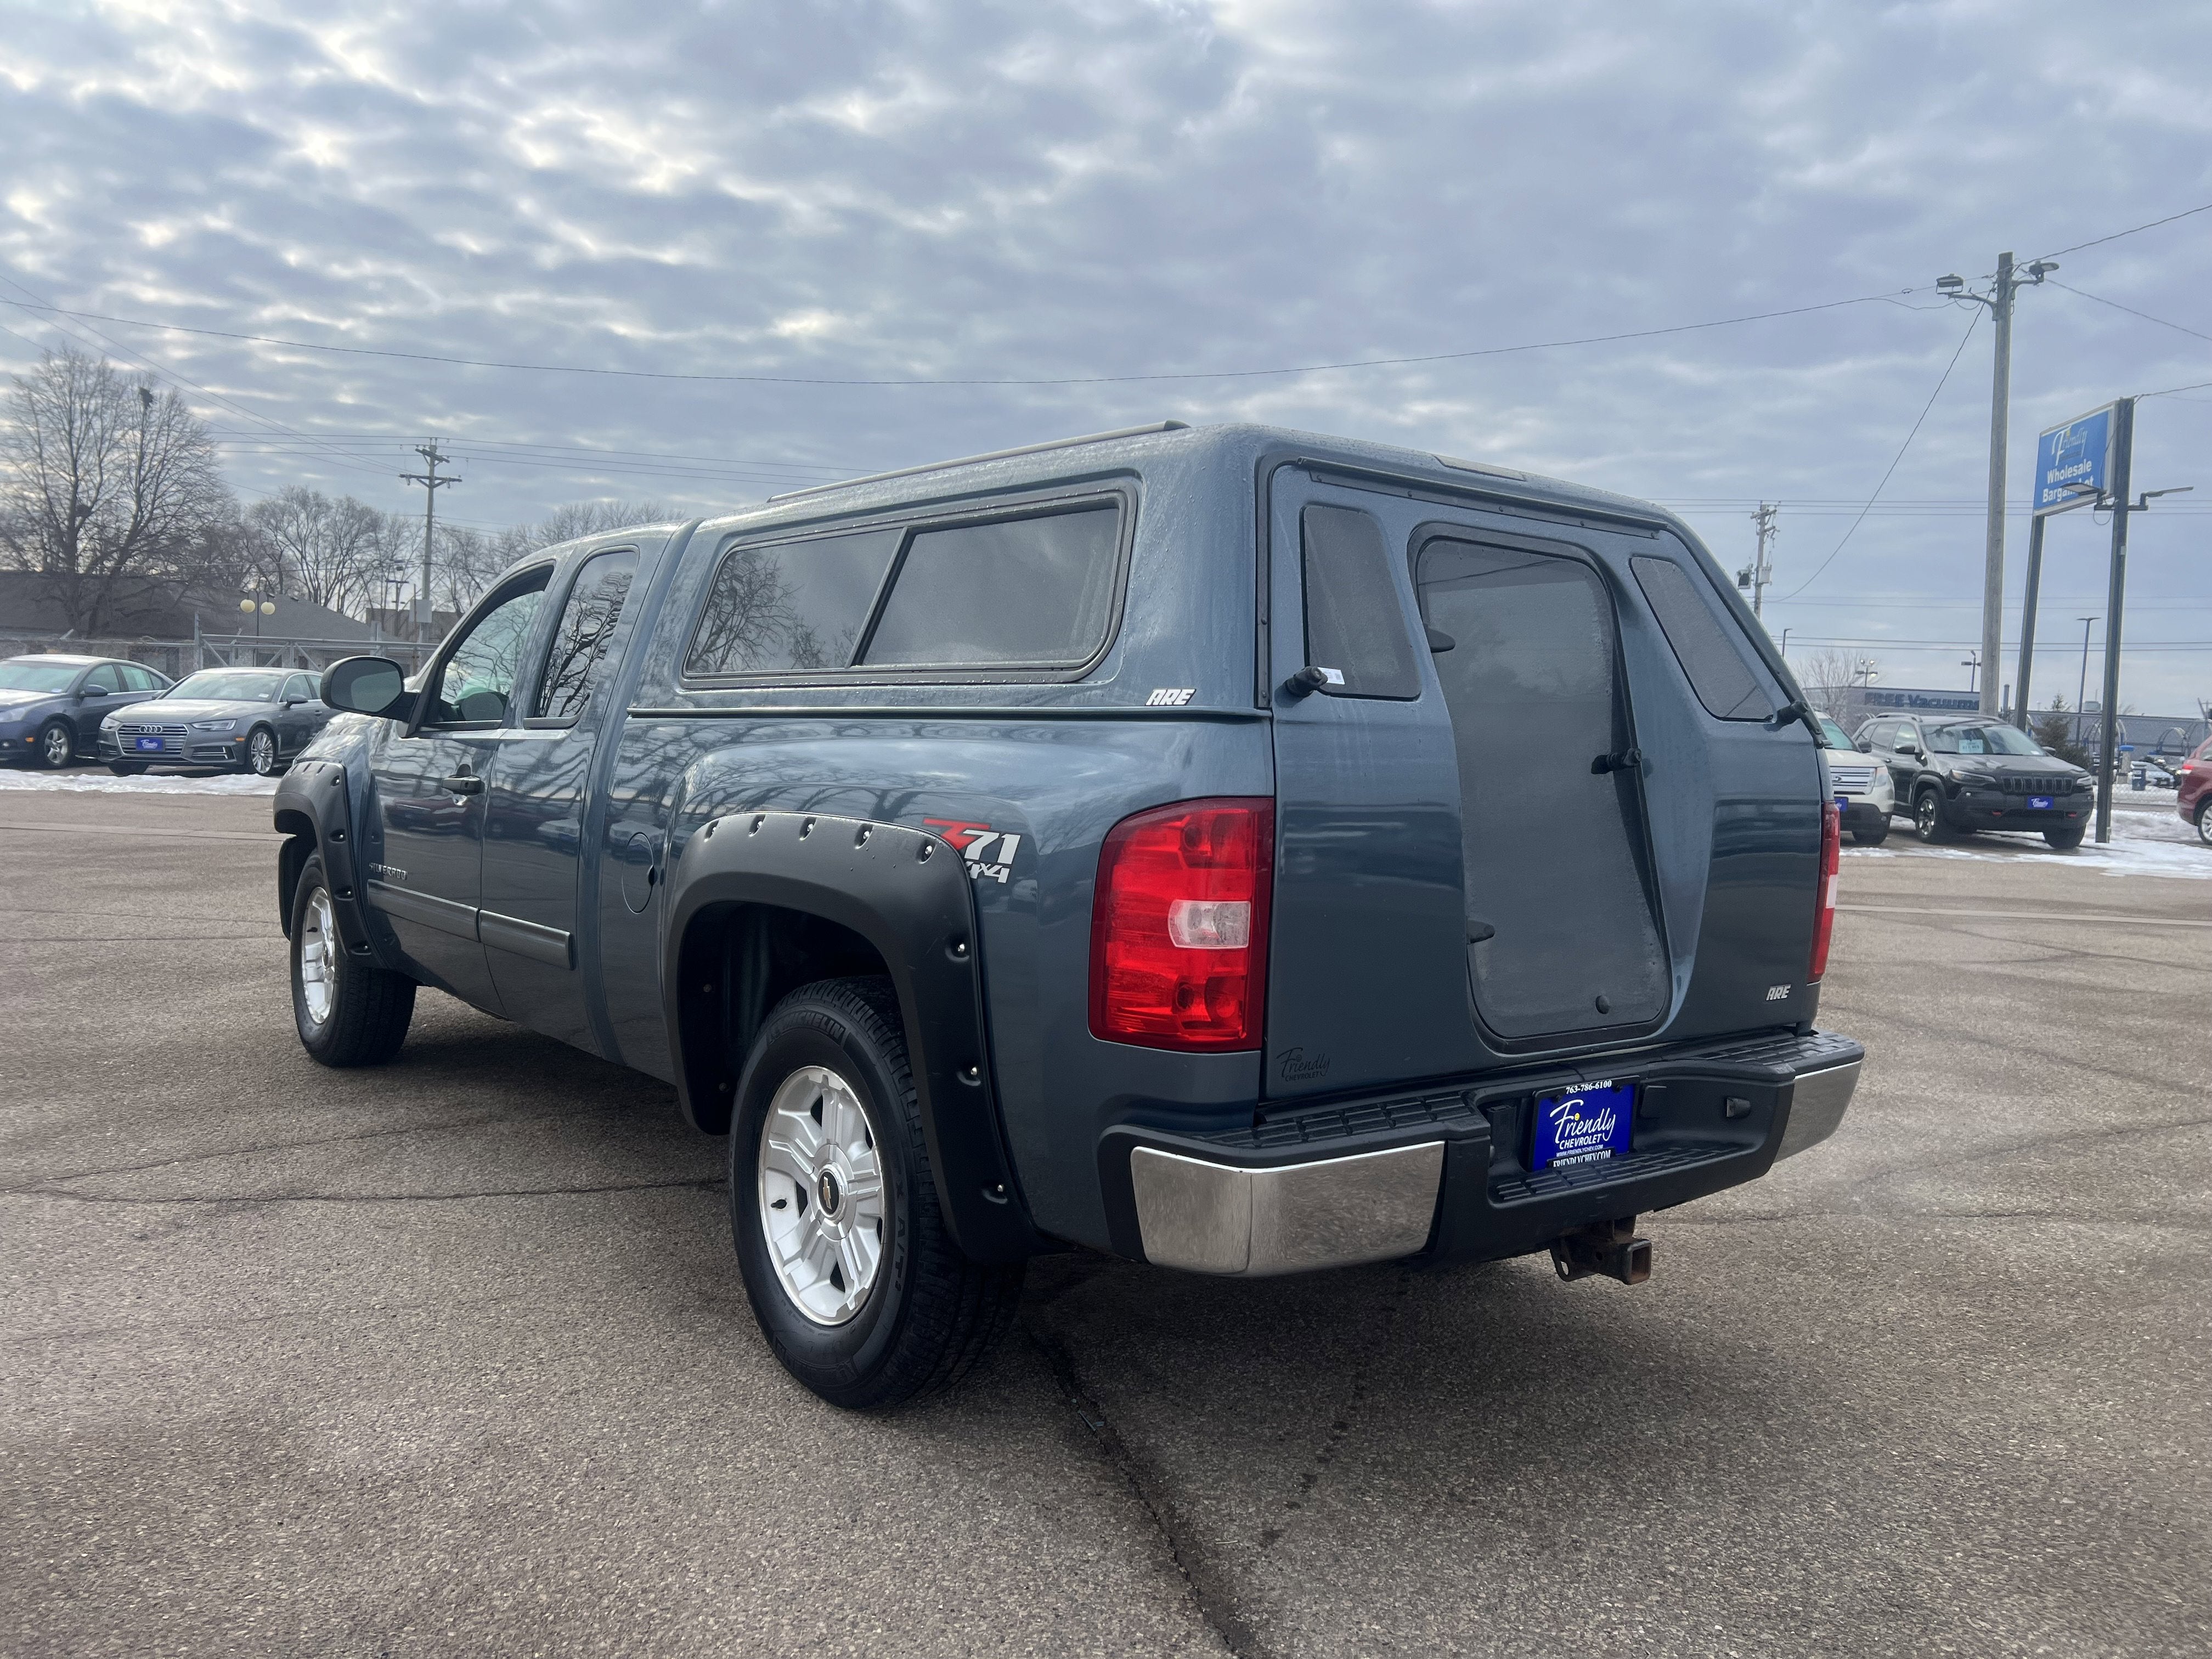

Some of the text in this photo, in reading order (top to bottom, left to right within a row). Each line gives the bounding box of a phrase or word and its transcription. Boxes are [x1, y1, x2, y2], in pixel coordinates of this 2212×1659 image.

[2047, 459, 2092, 484] Wholesale
[1146, 688, 1196, 706] ARE
[1865, 692, 1906, 707] FREE
[369, 862, 408, 881] SILVERADO
[1766, 984, 1791, 1001] ARE
[768, 1012, 844, 1042] MICHELIN
[1276, 1047, 1330, 1077] Friendly
[1285, 1071, 1319, 1082] CHEVROLET
[1565, 1080, 1612, 1095] 763-786-6100
[1549, 1099, 1616, 1144] Friendly
[1559, 1133, 1602, 1150] CHEVROLET
